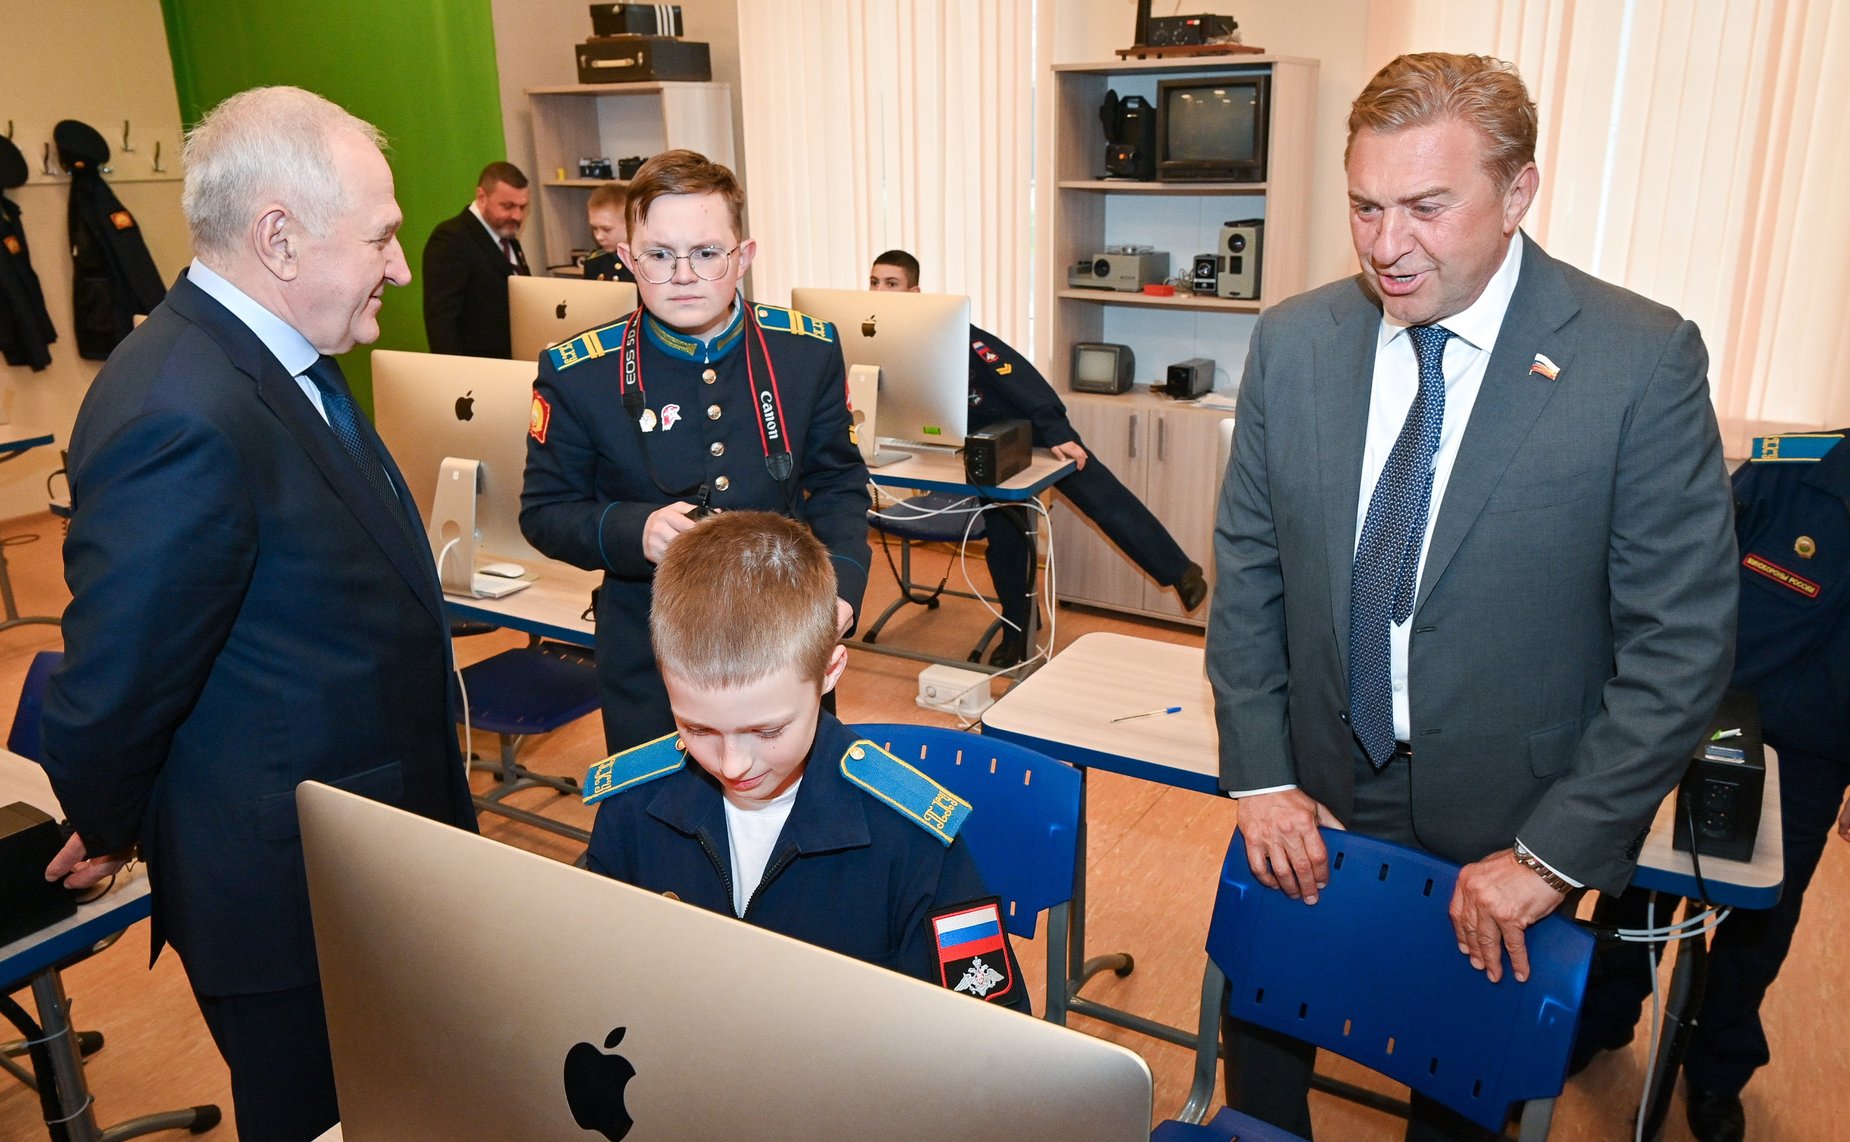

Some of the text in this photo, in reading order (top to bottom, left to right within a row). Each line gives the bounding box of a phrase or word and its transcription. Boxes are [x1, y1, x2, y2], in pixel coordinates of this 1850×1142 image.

[625, 329, 637, 385] EOS 5D
[760, 390, 779, 440] Canon
[1788, 577, 1816, 594] РОССИИ
[923, 789, 959, 830] ПКУ
